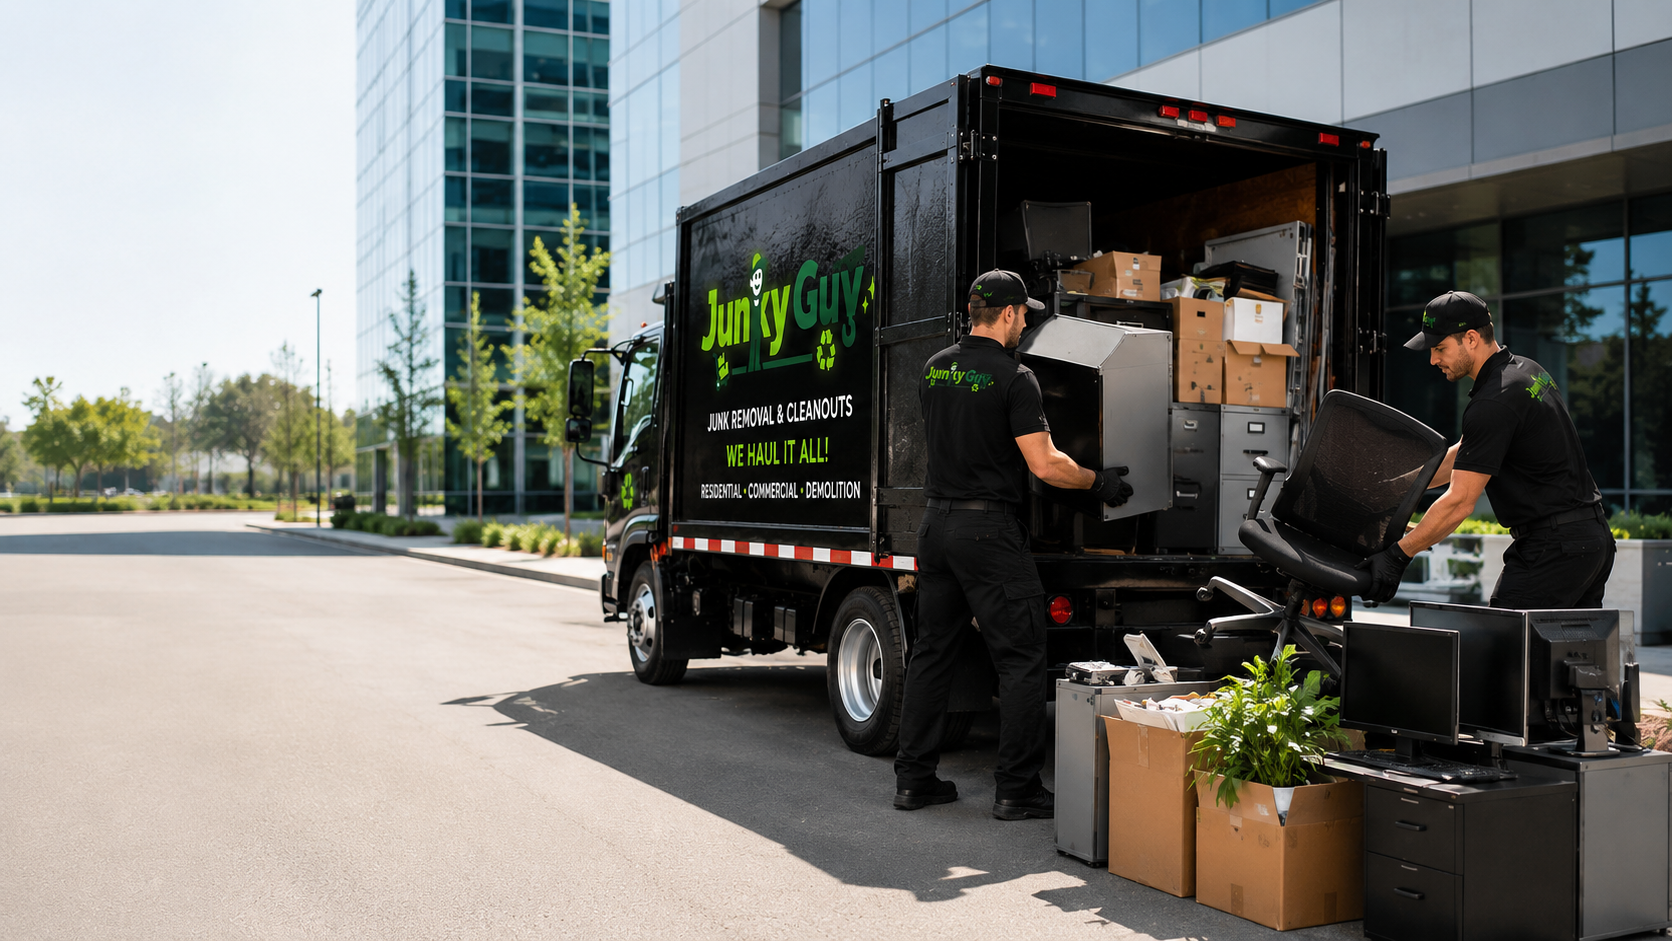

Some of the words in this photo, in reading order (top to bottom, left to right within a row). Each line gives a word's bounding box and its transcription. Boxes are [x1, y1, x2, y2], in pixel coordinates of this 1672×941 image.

[793, 259, 865, 348] Guy
[707, 410, 730, 432] JUNK
[731, 405, 775, 429] REMOVAL
[777, 403, 784, 424] &
[786, 394, 853, 423] CLEANOUTS
[726, 443, 744, 468] WE
[747, 441, 780, 467] HAUL
[784, 439, 795, 464] IT
[799, 436, 829, 464] ALL!
[700, 483, 743, 499] RESIDENTIAL
[748, 482, 798, 499] COMMERCIAL
[806, 480, 861, 499] DEMOLITION
